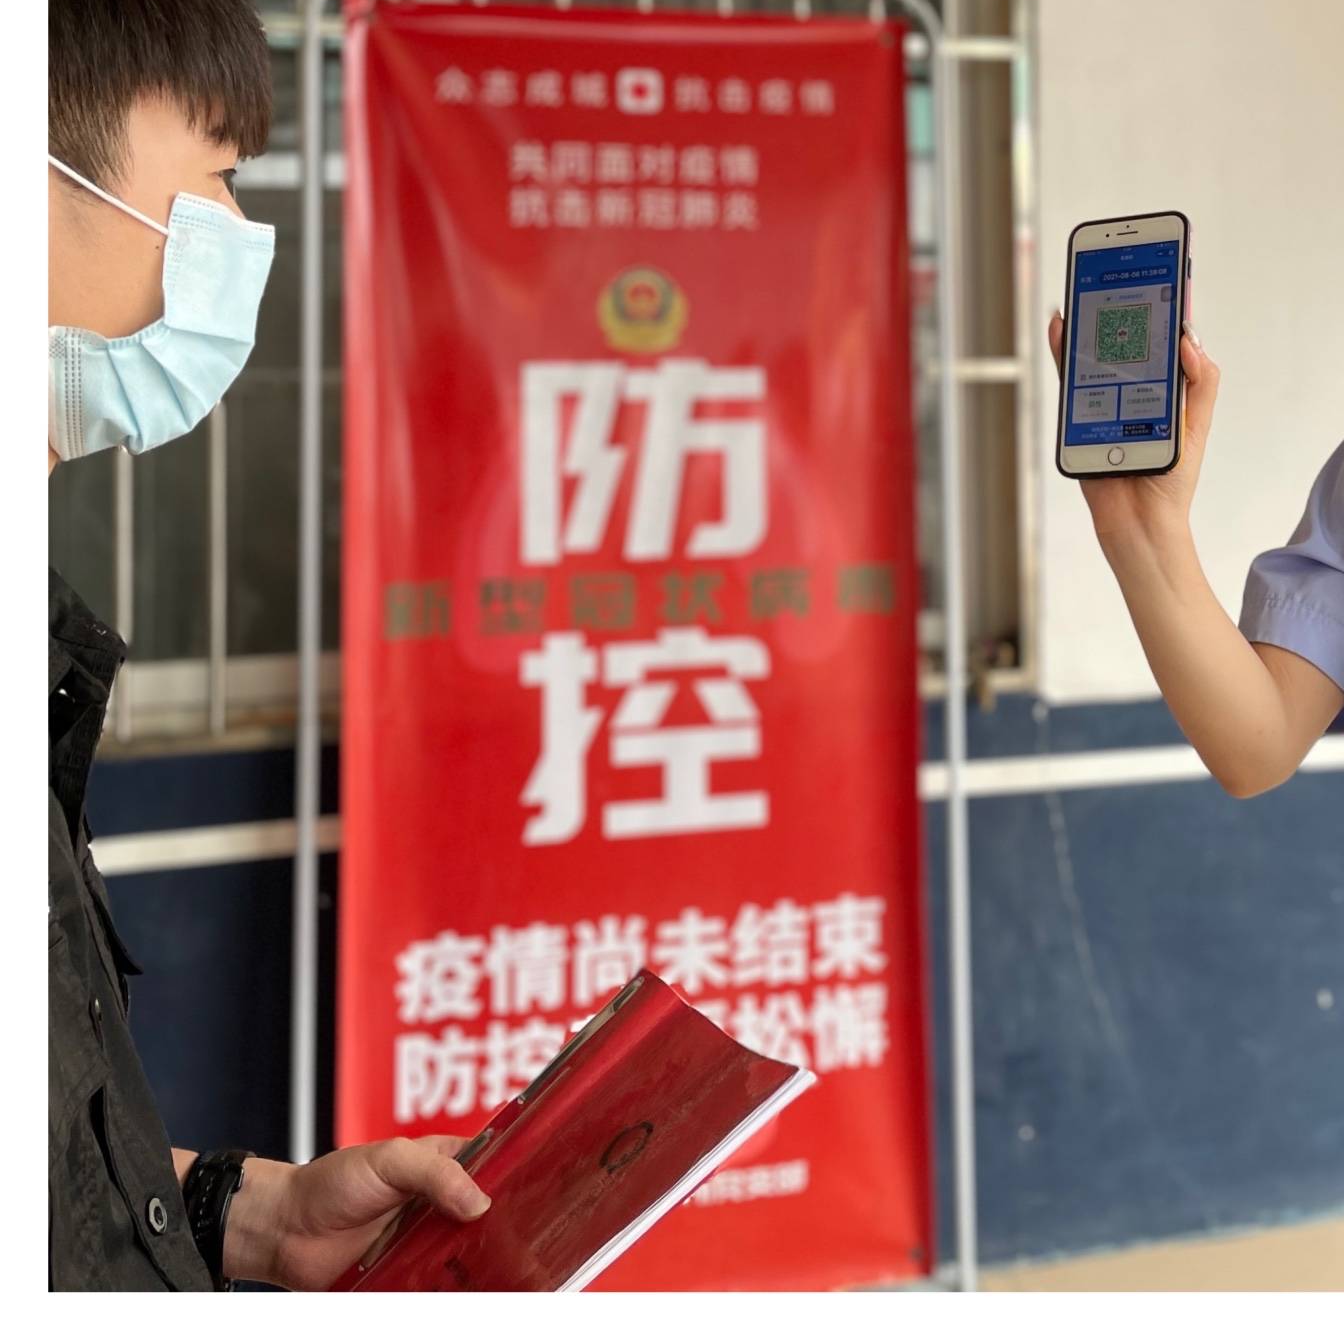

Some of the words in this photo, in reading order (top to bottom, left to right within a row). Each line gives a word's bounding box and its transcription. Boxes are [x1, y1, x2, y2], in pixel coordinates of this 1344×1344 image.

[520, 358, 768, 566] 防
[518, 627, 772, 847] 控
[394, 893, 888, 1023] 疫情尚未结束
[393, 984, 889, 1122] 防控松懈
